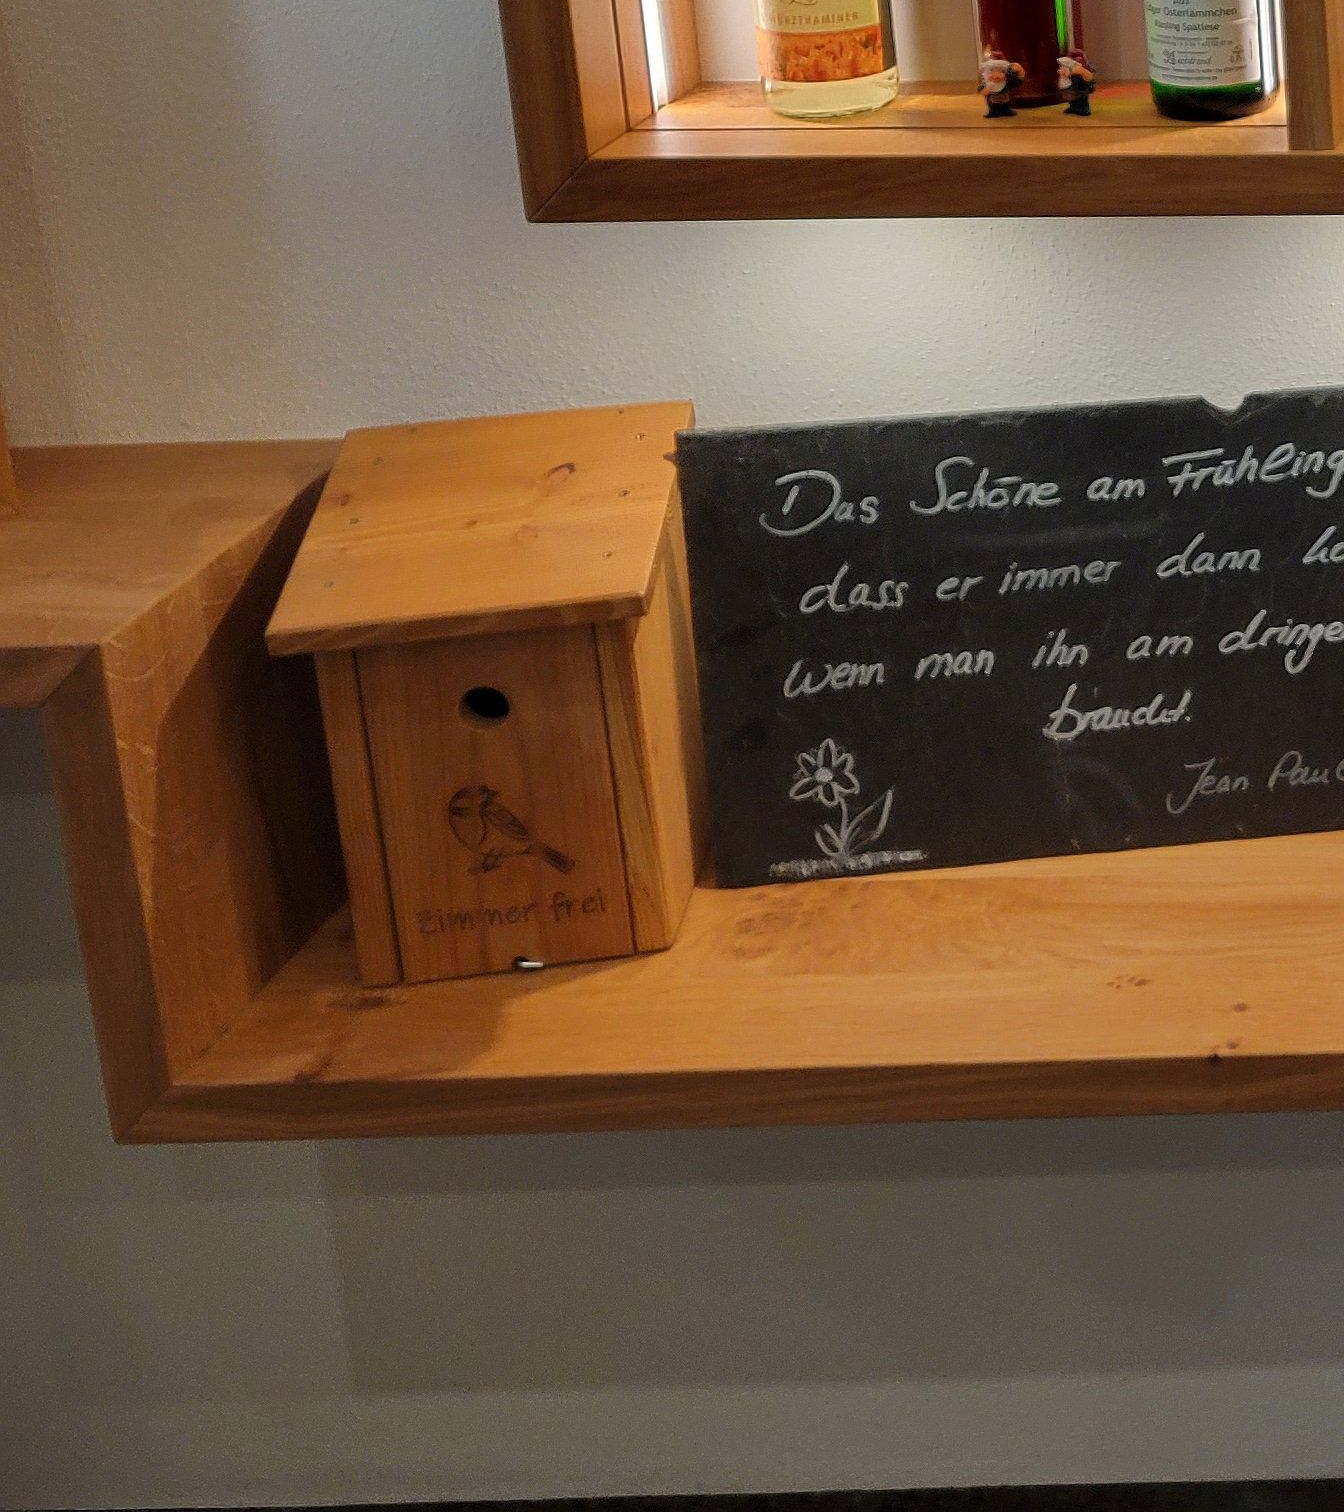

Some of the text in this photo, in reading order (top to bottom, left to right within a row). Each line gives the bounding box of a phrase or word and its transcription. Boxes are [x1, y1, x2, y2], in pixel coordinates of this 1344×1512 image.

[759, 469, 880, 536] Das
[909, 456, 1063, 515] Schöne
[1086, 475, 1147, 501] am
[799, 561, 910, 614] dass
[935, 574, 985, 601] er
[998, 558, 1122, 595] immer
[1156, 532, 1262, 579] dann
[914, 649, 995, 679] man
[1031, 628, 1089, 669] ihn
[1126, 635, 1194, 660] am
[1042, 683, 1193, 741] braucht.
[1165, 756, 1250, 814] Jean
